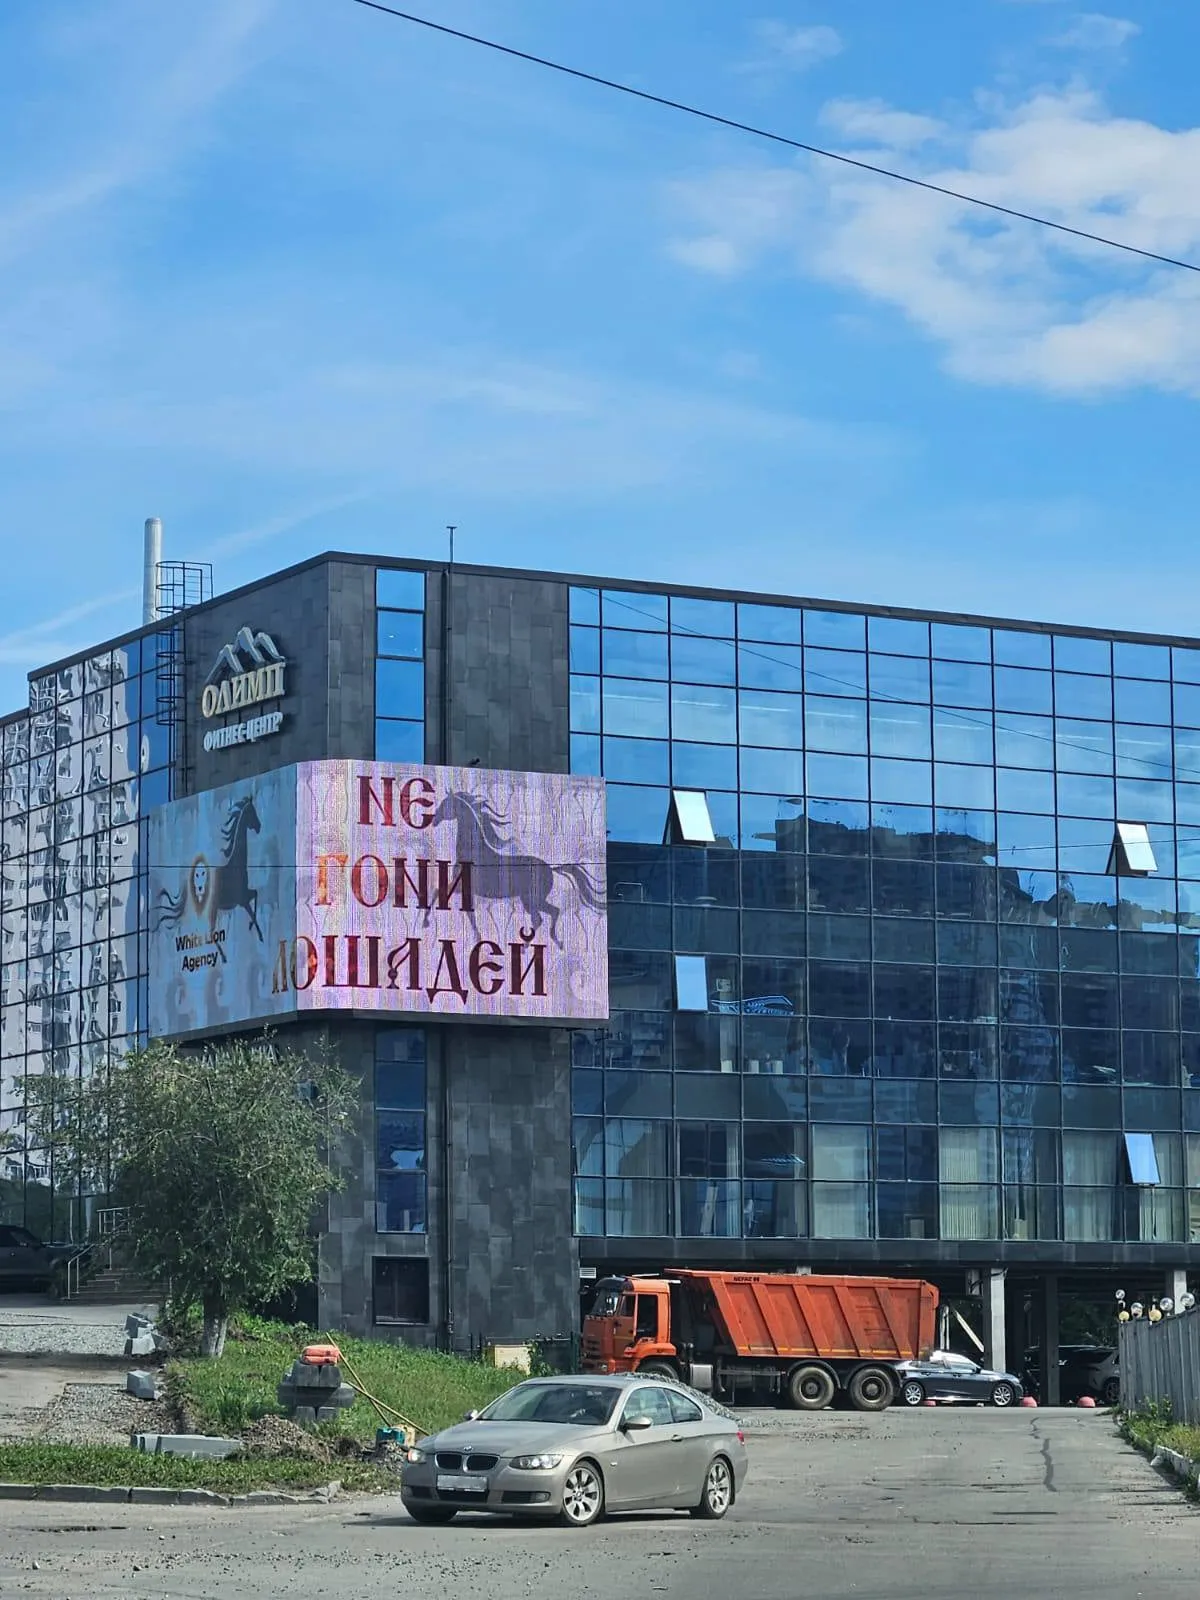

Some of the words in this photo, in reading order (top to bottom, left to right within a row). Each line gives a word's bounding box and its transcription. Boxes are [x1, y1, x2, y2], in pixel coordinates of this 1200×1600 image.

[202, 662, 286, 718] ОЛИМП
[203, 711, 283, 753] ФИТНЕС-ЦЕНТР
[314, 854, 474, 912] ГОНИ
[181, 951, 218, 973] Agency
[271, 926, 547, 1005] ЛОШАДЕЙ
